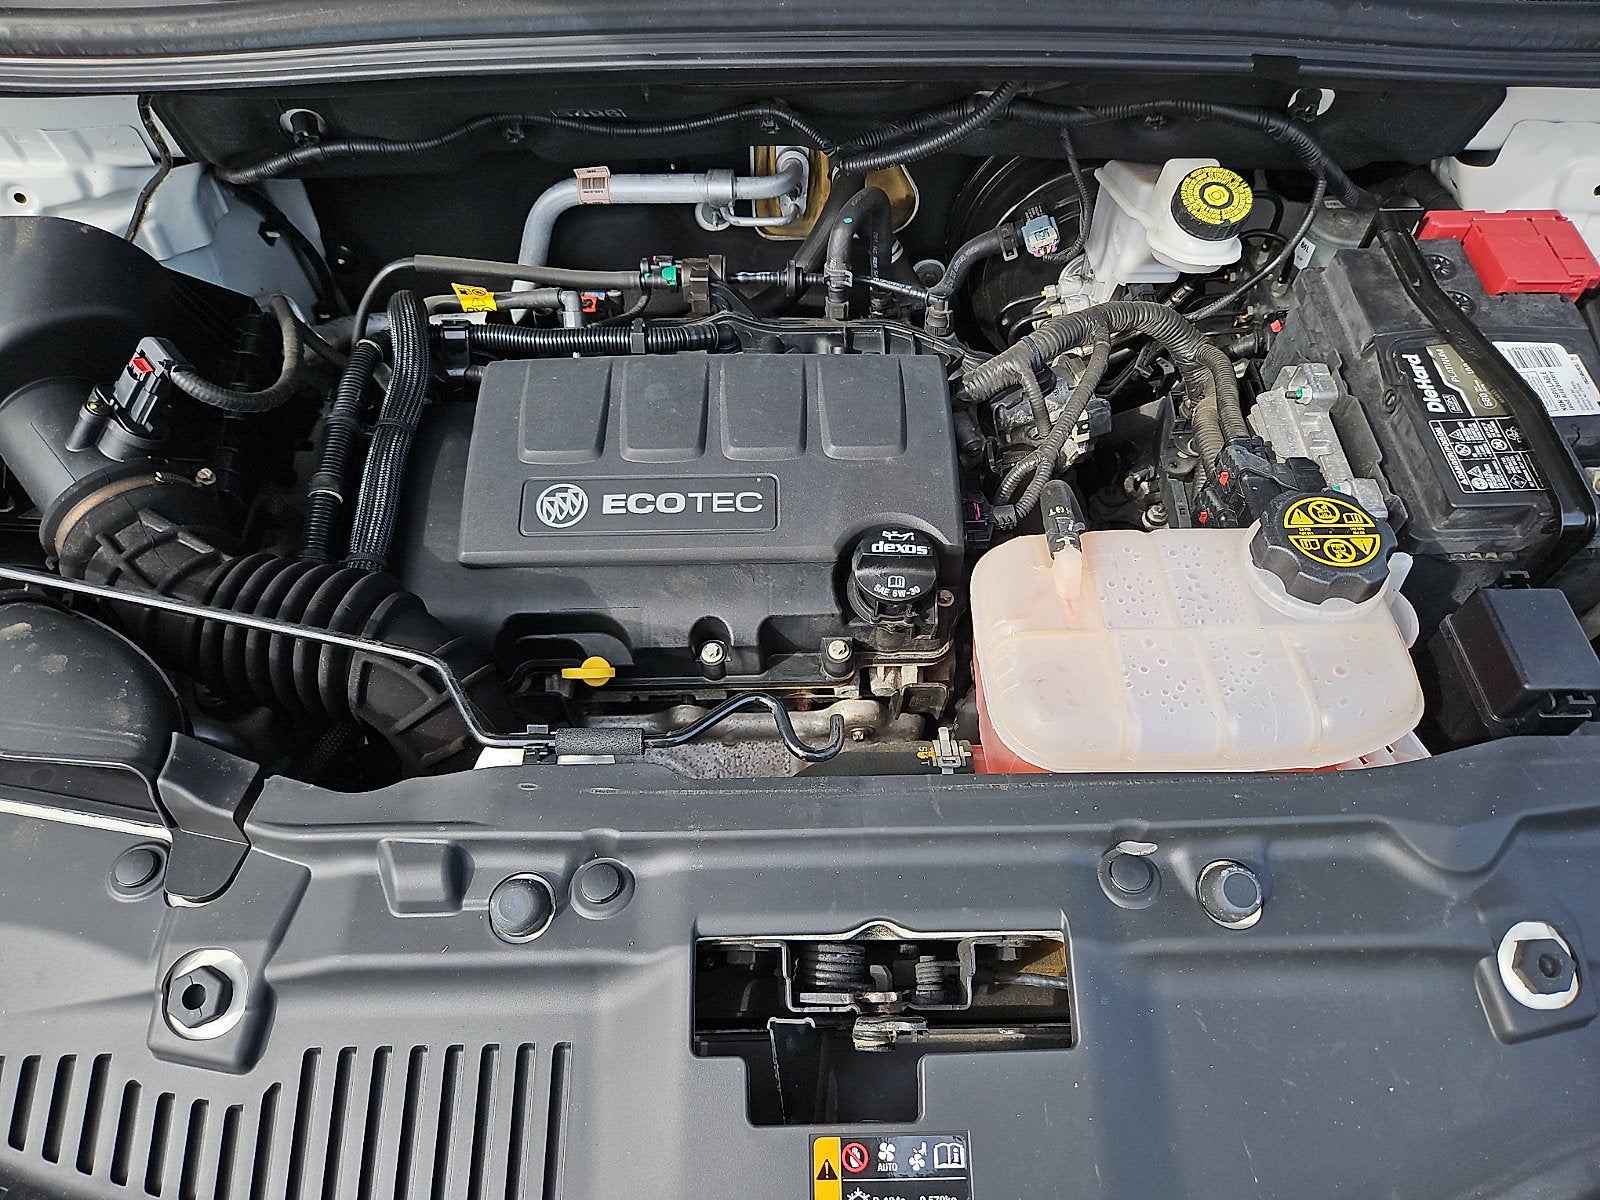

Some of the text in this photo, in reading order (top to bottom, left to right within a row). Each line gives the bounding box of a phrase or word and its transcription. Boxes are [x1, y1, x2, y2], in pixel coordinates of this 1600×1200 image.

[1436, 348, 1460, 384] PLATINUM
[1402, 354, 1446, 413] DieHard
[602, 491, 763, 515] ECOTEC
[871, 541, 928, 555] dexos
[873, 584, 921, 598] SAE 5W-30
[877, 1162, 899, 1172] AUTO
